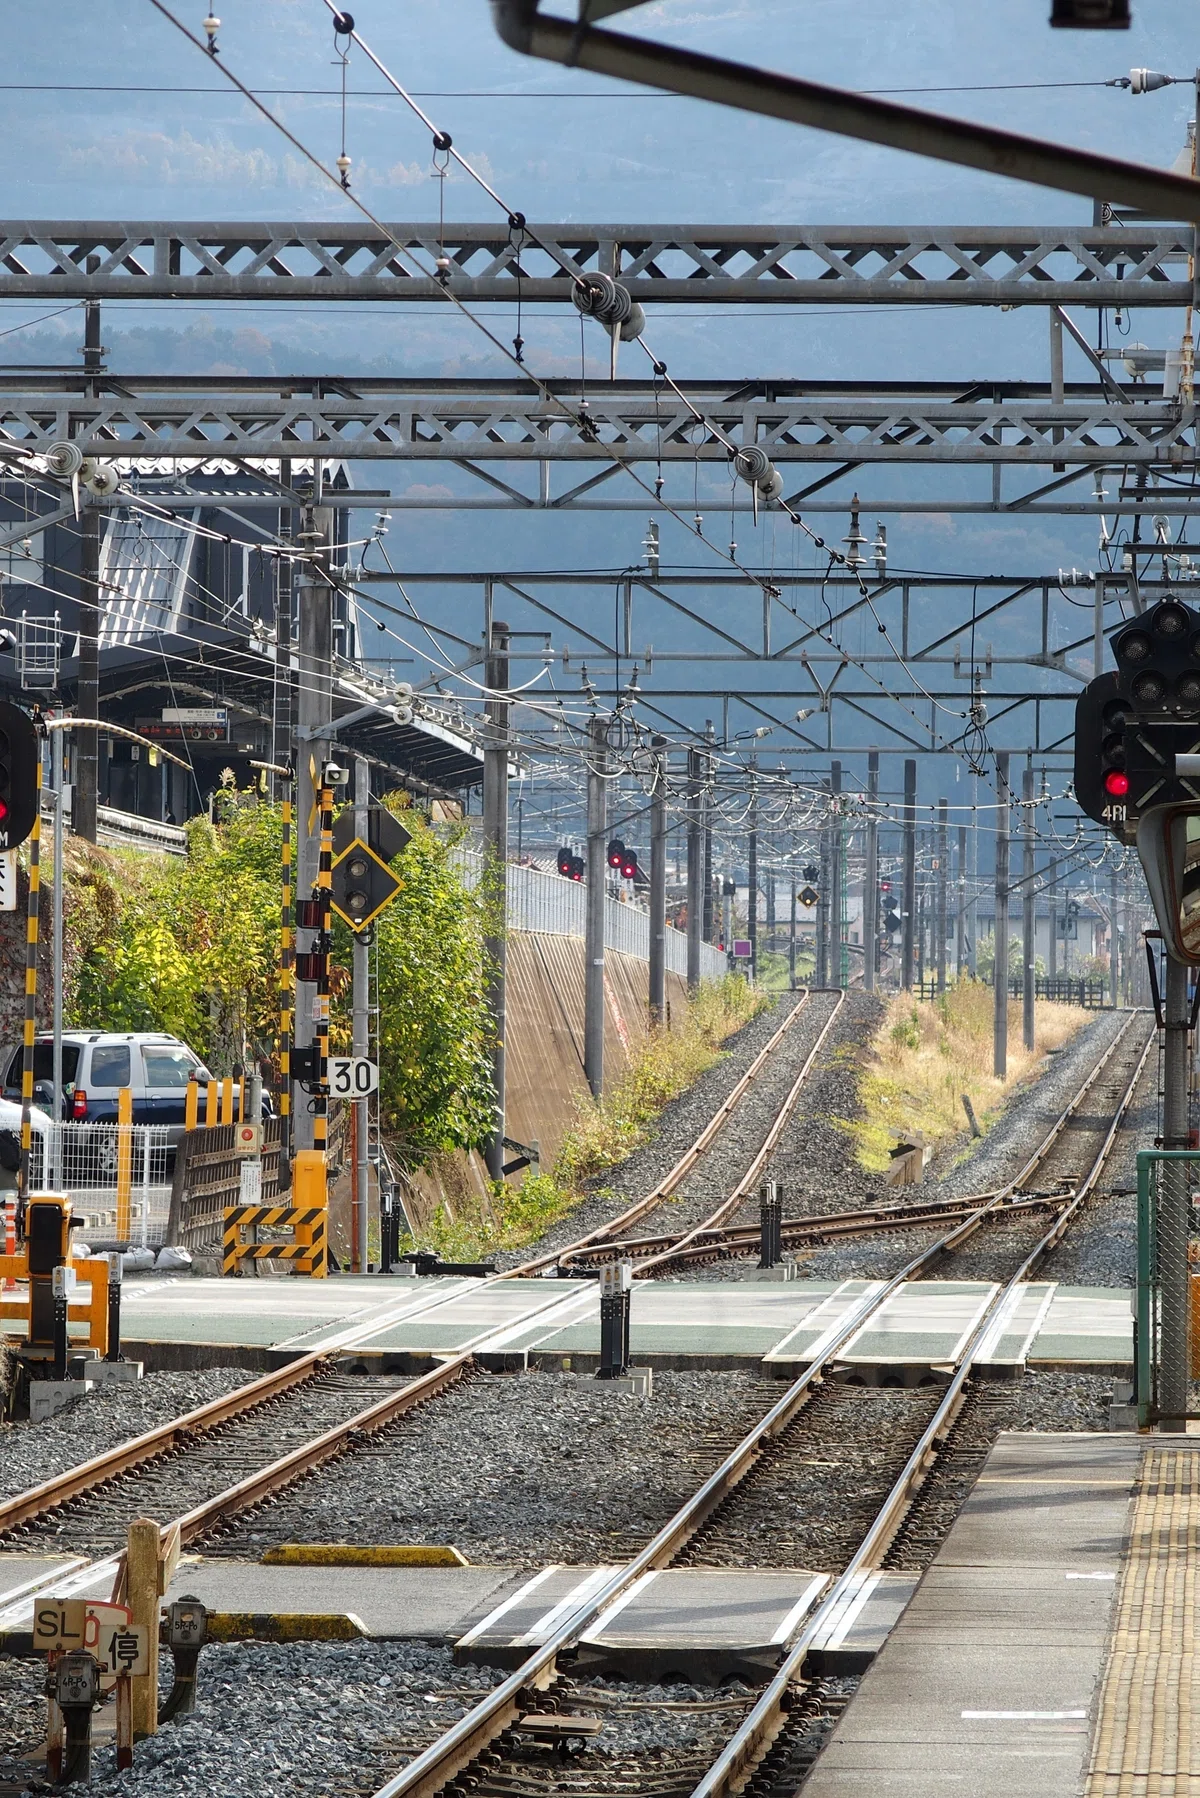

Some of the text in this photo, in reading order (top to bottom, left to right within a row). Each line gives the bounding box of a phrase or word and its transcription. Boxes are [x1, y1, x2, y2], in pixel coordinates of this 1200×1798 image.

[335, 1061, 371, 1093] 30
[36, 1610, 80, 1638] SL
[108, 1631, 139, 1671] 停
